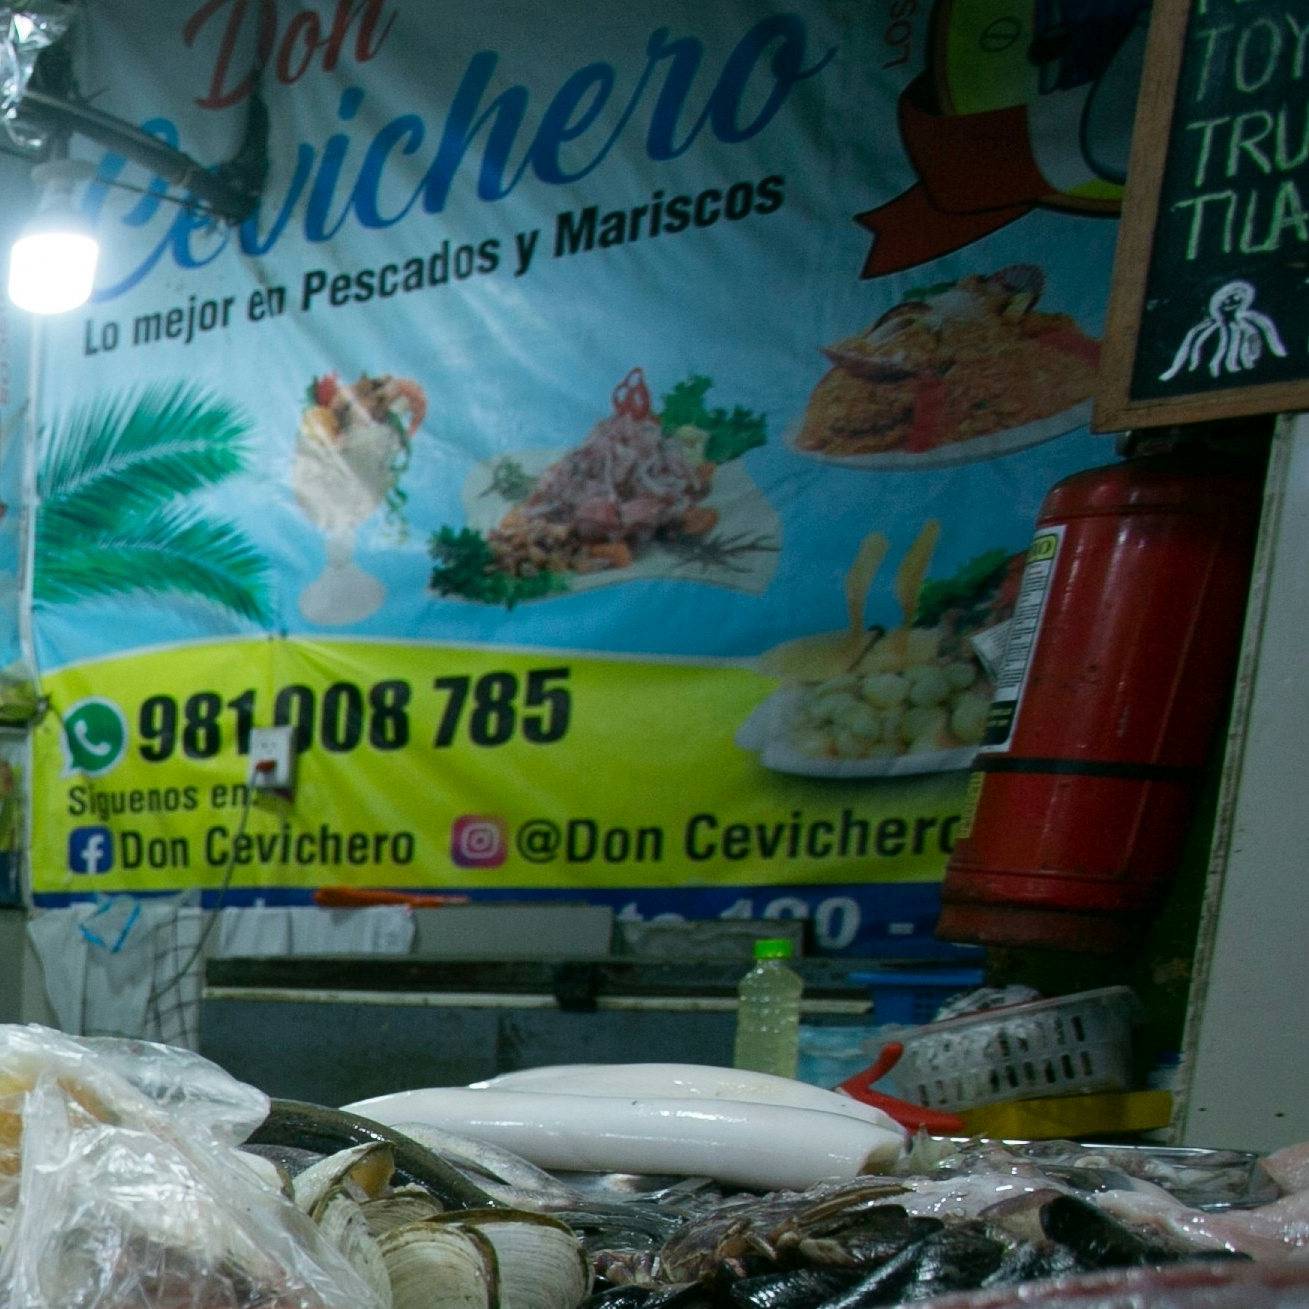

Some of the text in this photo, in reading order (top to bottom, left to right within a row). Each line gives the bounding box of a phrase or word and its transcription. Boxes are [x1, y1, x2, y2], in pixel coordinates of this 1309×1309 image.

[182, 0, 399, 110] Don
[84, 174, 787, 356] Lo mejor en Pescados y Mariscos
[139, 667, 573, 763] 981 008 785
[119, 821, 416, 870] Don Cevichero
[516, 818, 664, 864] @Don
